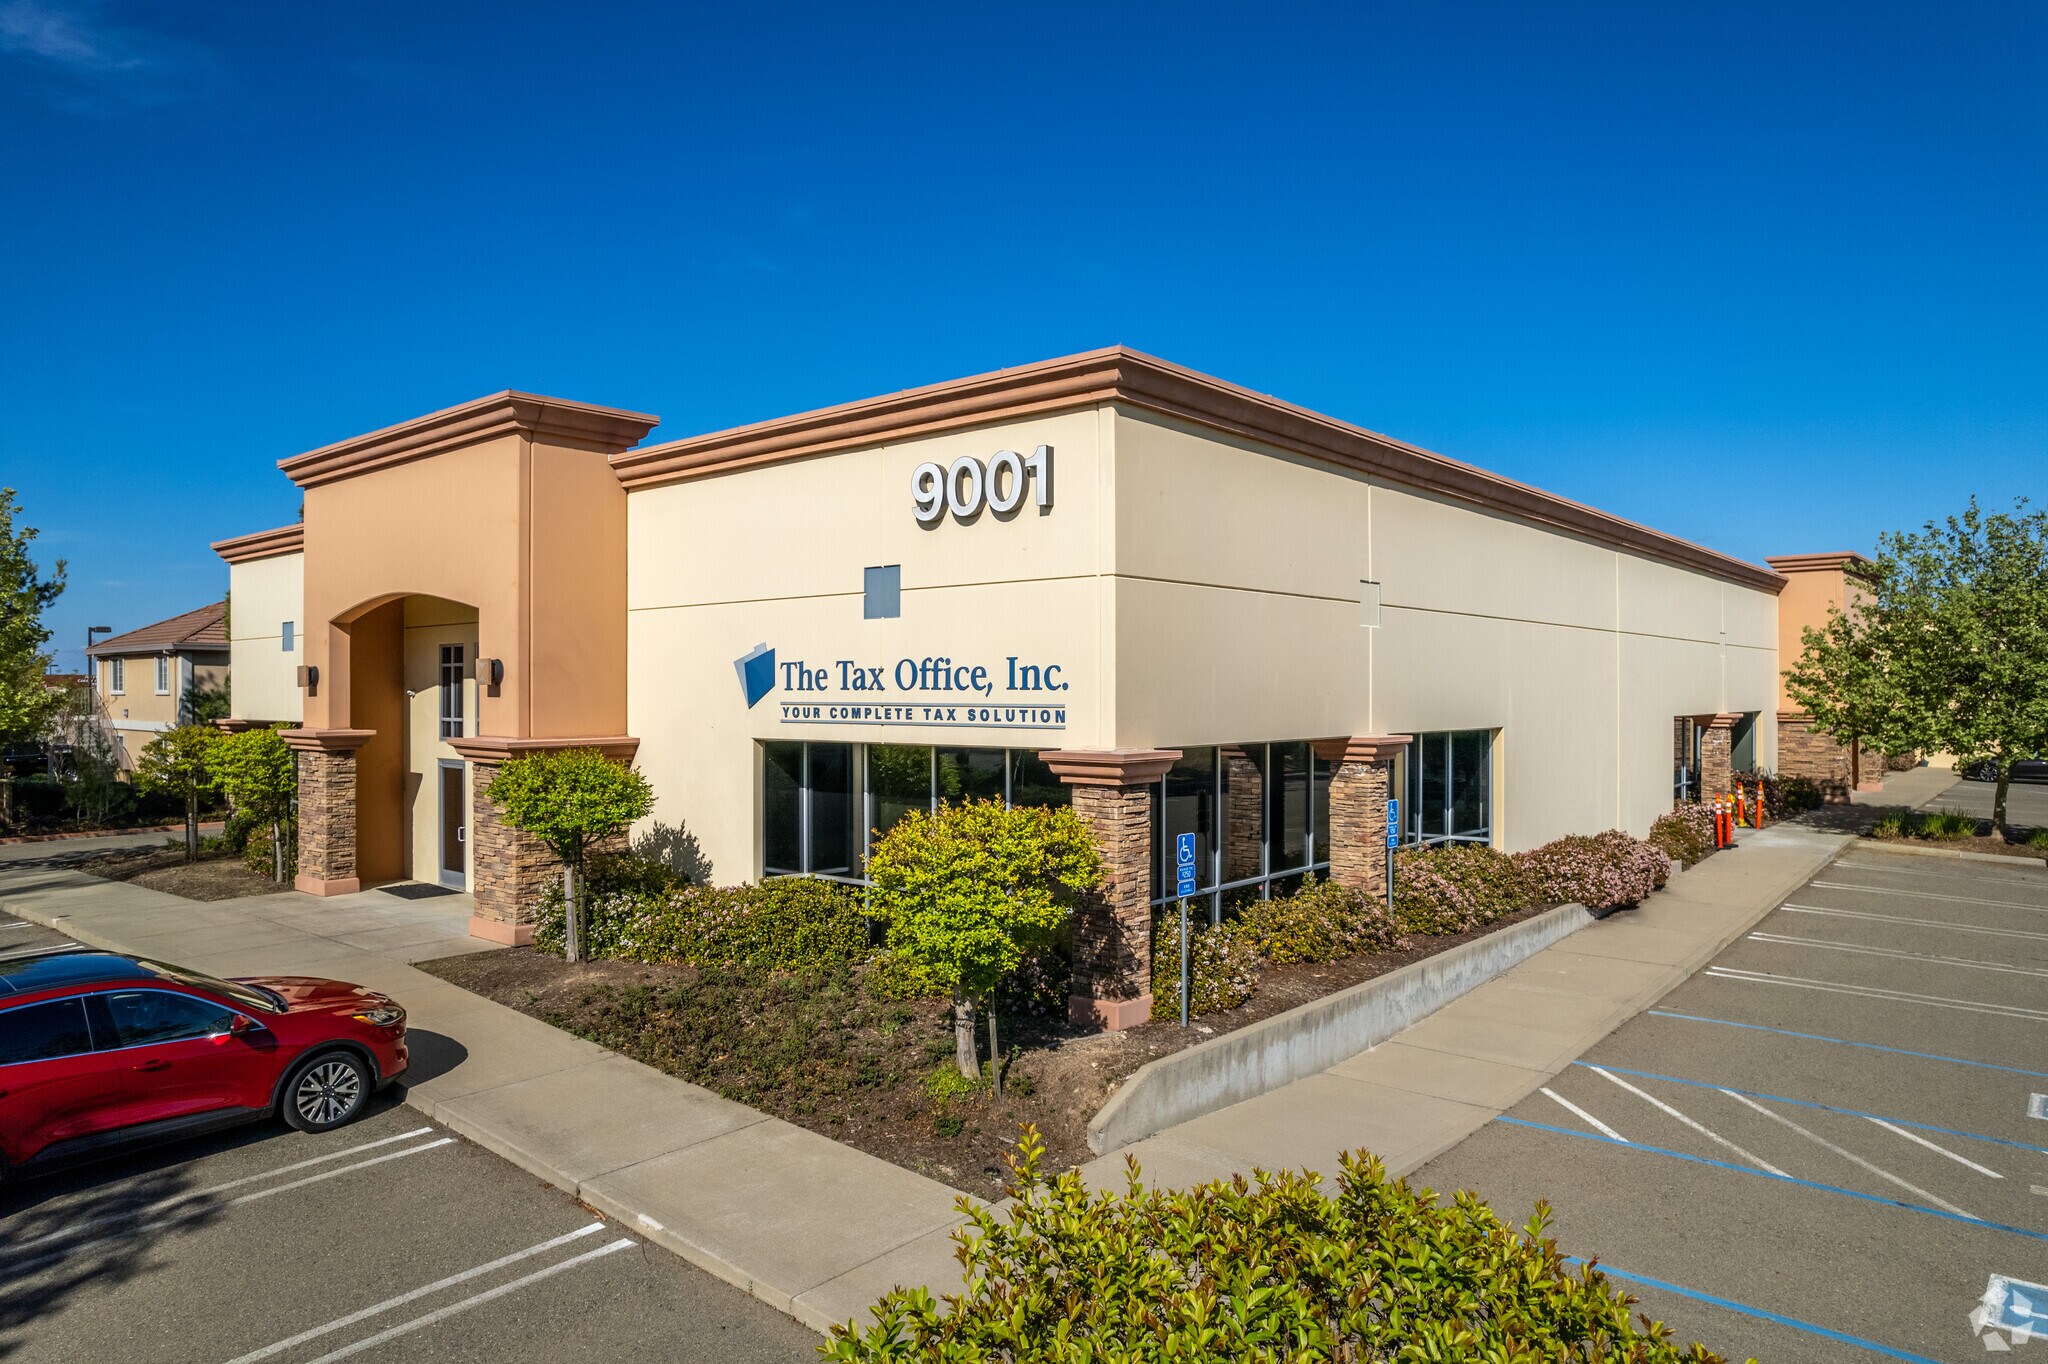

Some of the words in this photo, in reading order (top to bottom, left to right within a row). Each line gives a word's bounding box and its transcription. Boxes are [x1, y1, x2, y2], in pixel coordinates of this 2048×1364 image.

[911, 445, 1054, 522] 9001
[780, 660, 828, 691] The
[835, 660, 885, 691] Tax
[895, 657, 993, 697] Office,
[1006, 656, 1069, 691] Inc.
[782, 706, 821, 719] YOUR
[829, 707, 913, 720] COMPLETE
[923, 708, 957, 721] TAX
[967, 708, 1066, 723] SOLUTION
